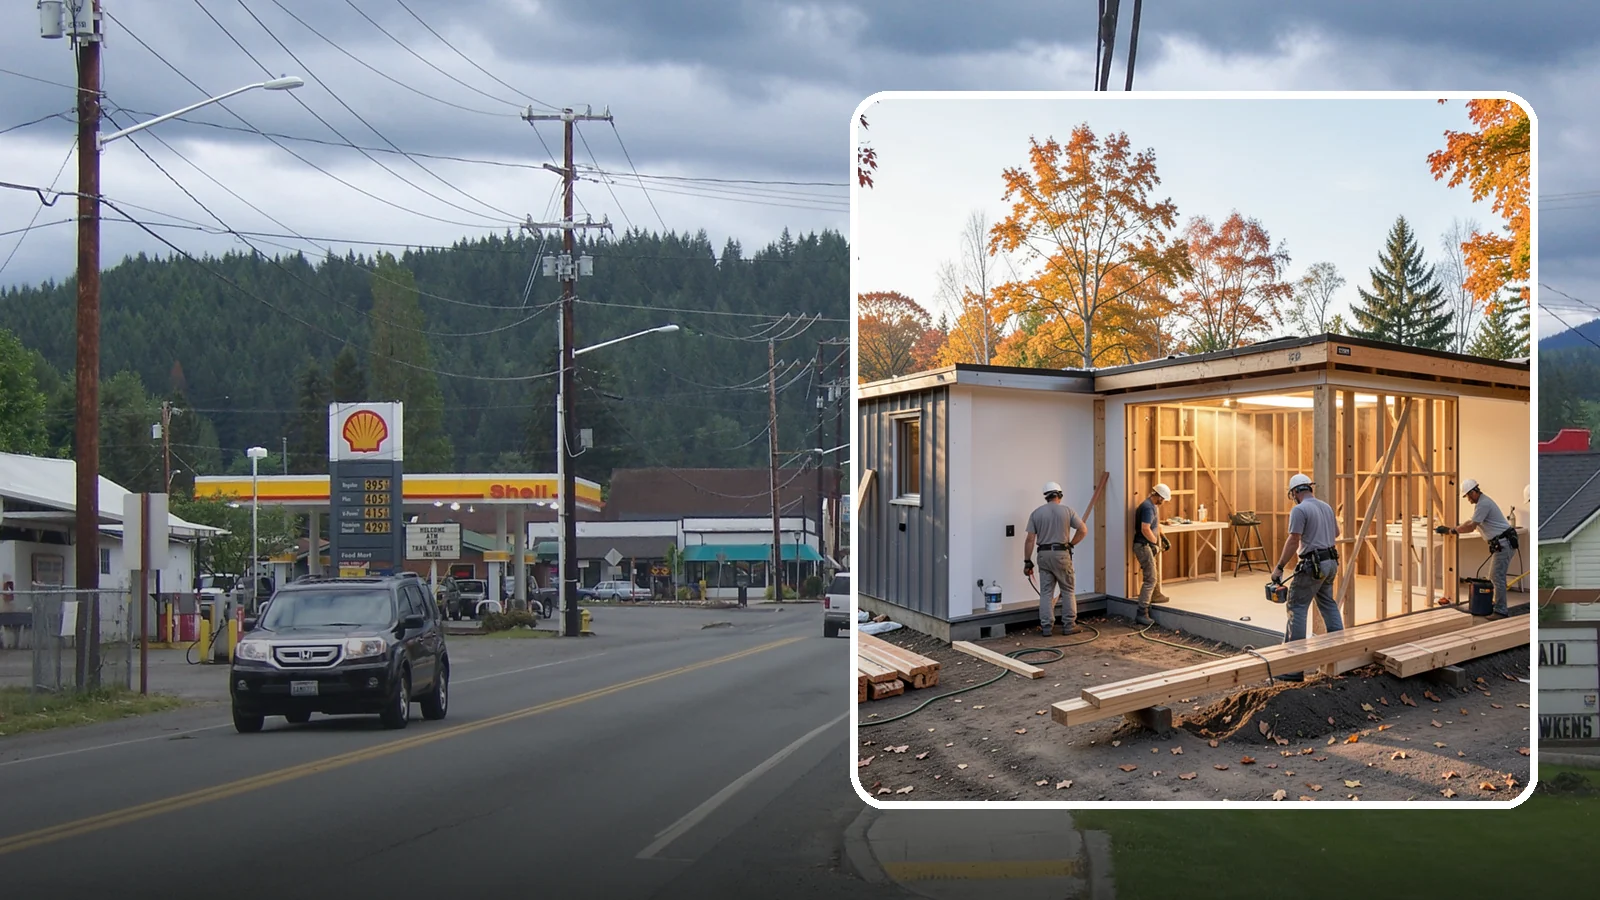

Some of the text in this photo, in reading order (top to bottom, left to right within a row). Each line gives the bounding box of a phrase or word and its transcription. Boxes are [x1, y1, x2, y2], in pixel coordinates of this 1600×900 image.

[490, 484, 547, 499] Shell
[1538, 643, 1567, 666] AID
[1538, 716, 1592, 738] WKENS
